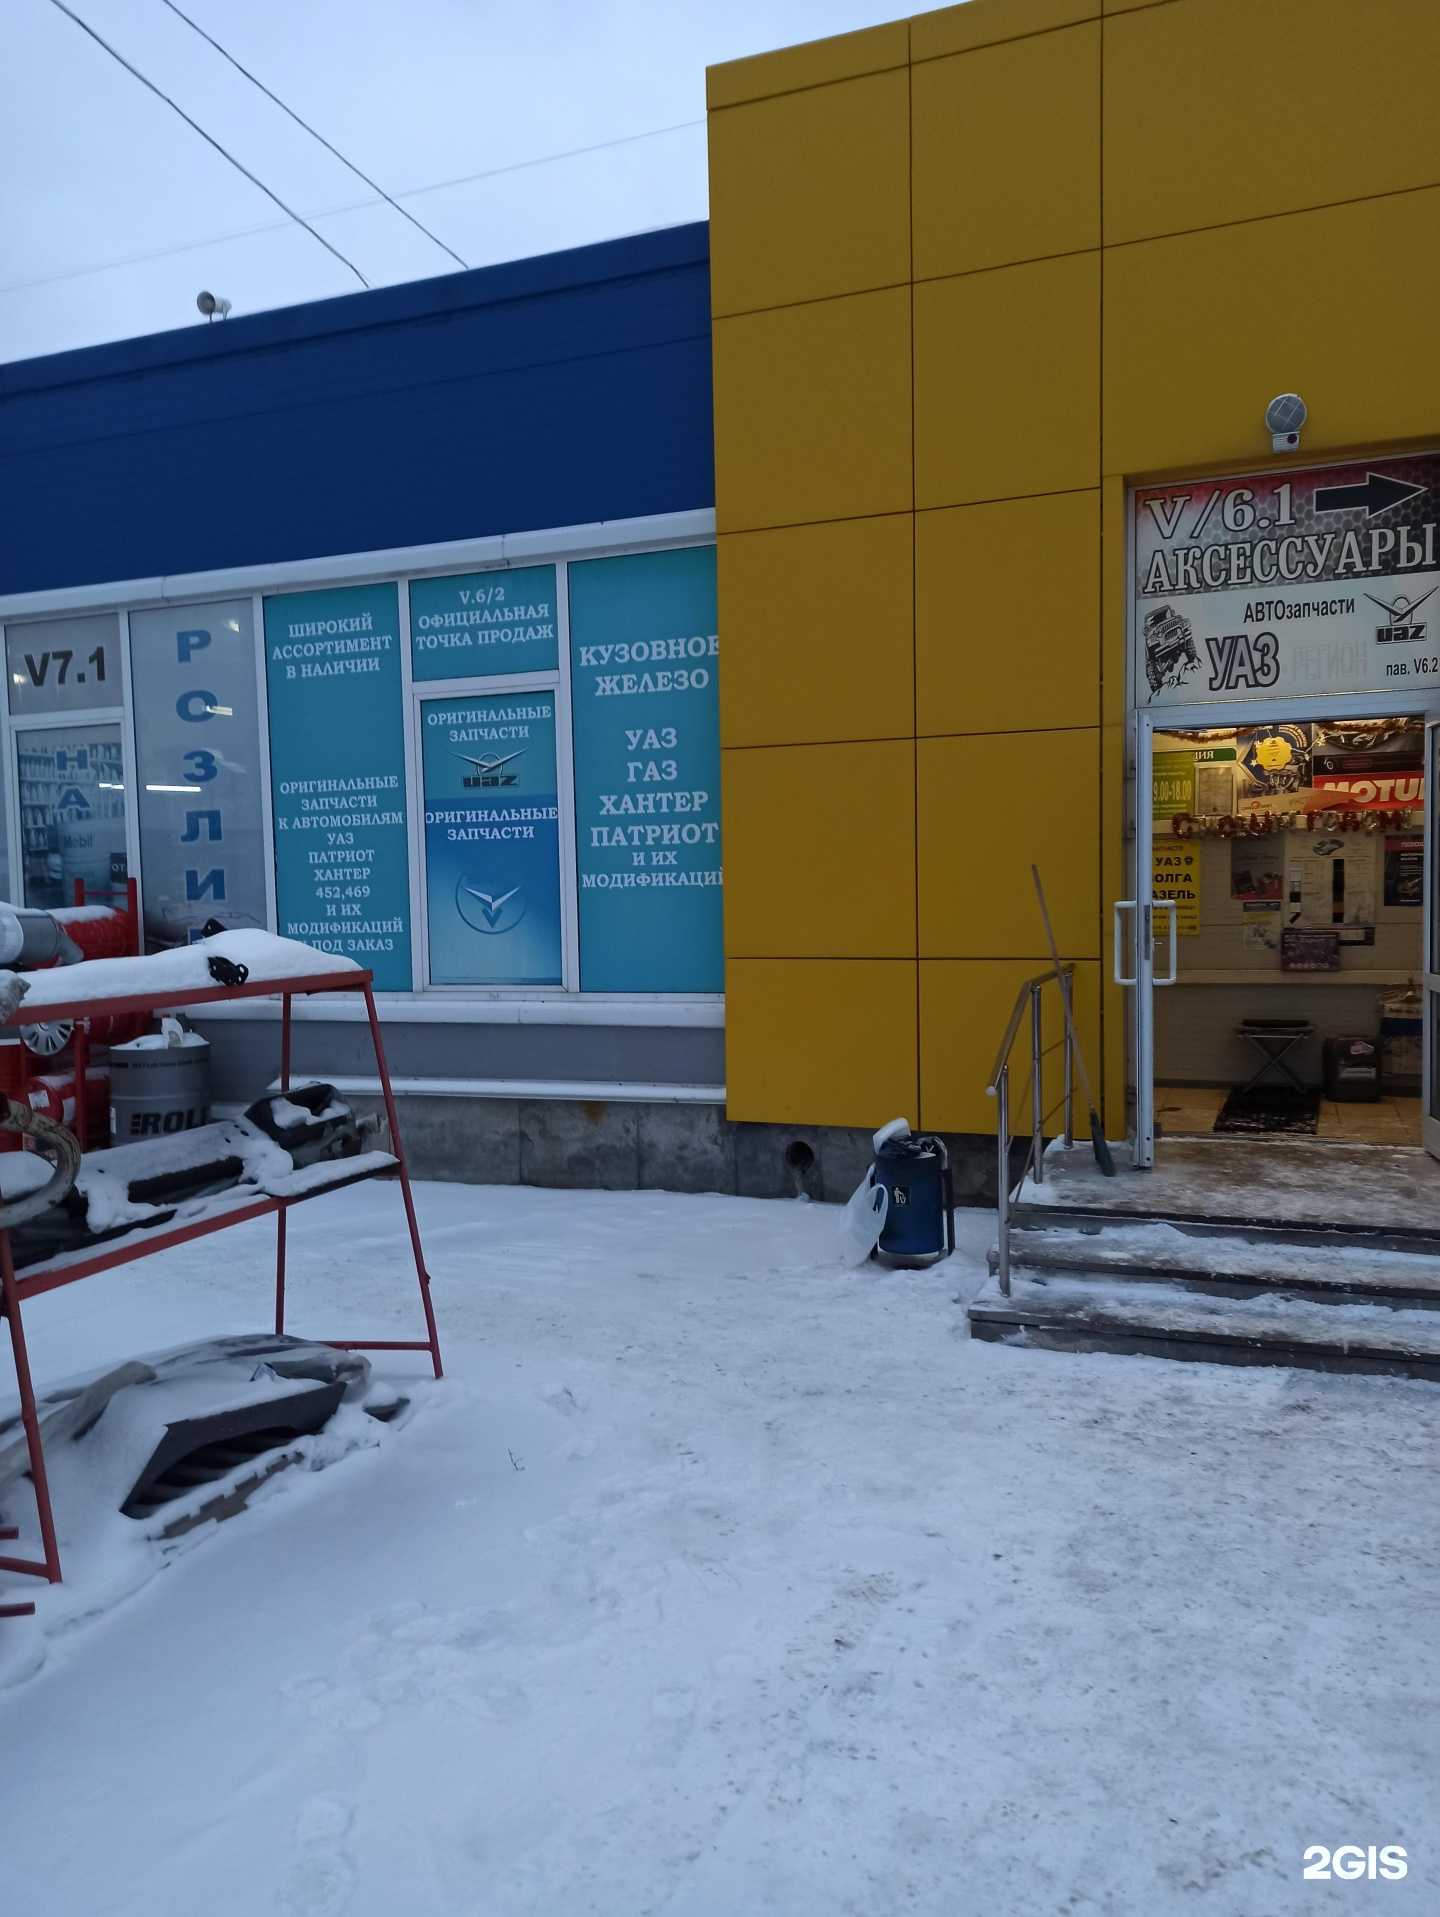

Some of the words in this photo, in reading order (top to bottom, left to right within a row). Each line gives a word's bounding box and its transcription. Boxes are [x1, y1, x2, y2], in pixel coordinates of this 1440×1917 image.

[1145, 483, 1297, 540] V/6.1
[1143, 523, 1438, 594] АКСЕССУАРЫ
[459, 587, 505, 606] V.6/2
[418, 603, 550, 630] ОФИЦИАЛЬНАЯ
[1243, 597, 1355, 624] АВТОзапчасти
[288, 612, 374, 639] ШИРОКИЙ
[271, 634, 393, 661] АССОРТИМЕНТ
[416, 633, 473, 651] ТОЧКА
[477, 624, 554, 648] ПРОДАЖ
[24, 646, 107, 687] V7.1
[286, 665, 297, 680] В
[301, 657, 381, 678] НАЛИЧИИ
[1204, 631, 1281, 692] УАЗ
[1386, 663, 1410, 677] пав.
[1413, 656, 1438, 675] V6.2
[594, 668, 710, 697] ЖЕЛЕЗО
[427, 705, 552, 726] ОРИГИНАЛЬНЫЕ
[449, 725, 530, 742] ЗАПЧАСТИ
[625, 727, 678, 751] УАЗ
[627, 760, 678, 783] ГАЗ
[279, 774, 399, 795] ОРИГИНАЛЬНЫЕ
[301, 795, 378, 811] ЗАПЧАСТИ
[599, 790, 709, 816] ХАНТЕР
[278, 817, 289, 831] К
[292, 811, 403, 829] АВТОМОБИЛЯМ
[425, 806, 559, 824] ОРИГИНАЛЬНЫЕ
[327, 832, 355, 846] УАЗ
[447, 826, 535, 841] ЗАПЧАСТИ
[590, 823, 719, 848] ПАТРИОТ
[308, 848, 375, 864] ПАТРИОТ
[632, 852, 646, 867] И
[651, 850, 678, 866] ИХ
[1155, 856, 1182, 867] УАЗ
[313, 867, 372, 882] ХАНТЕР
[1153, 873, 1193, 883] ОЛГА
[314, 885, 371, 901] 452,469
[1152, 889, 1196, 900] АЗЕЛЬ
[326, 904, 337, 917] И
[340, 903, 363, 916] ИХ
[287, 917, 404, 936] МОДИФИКАЦИЙ
[311, 940, 344, 953] ПОД
[348, 938, 394, 952] ЗАКАЗ
